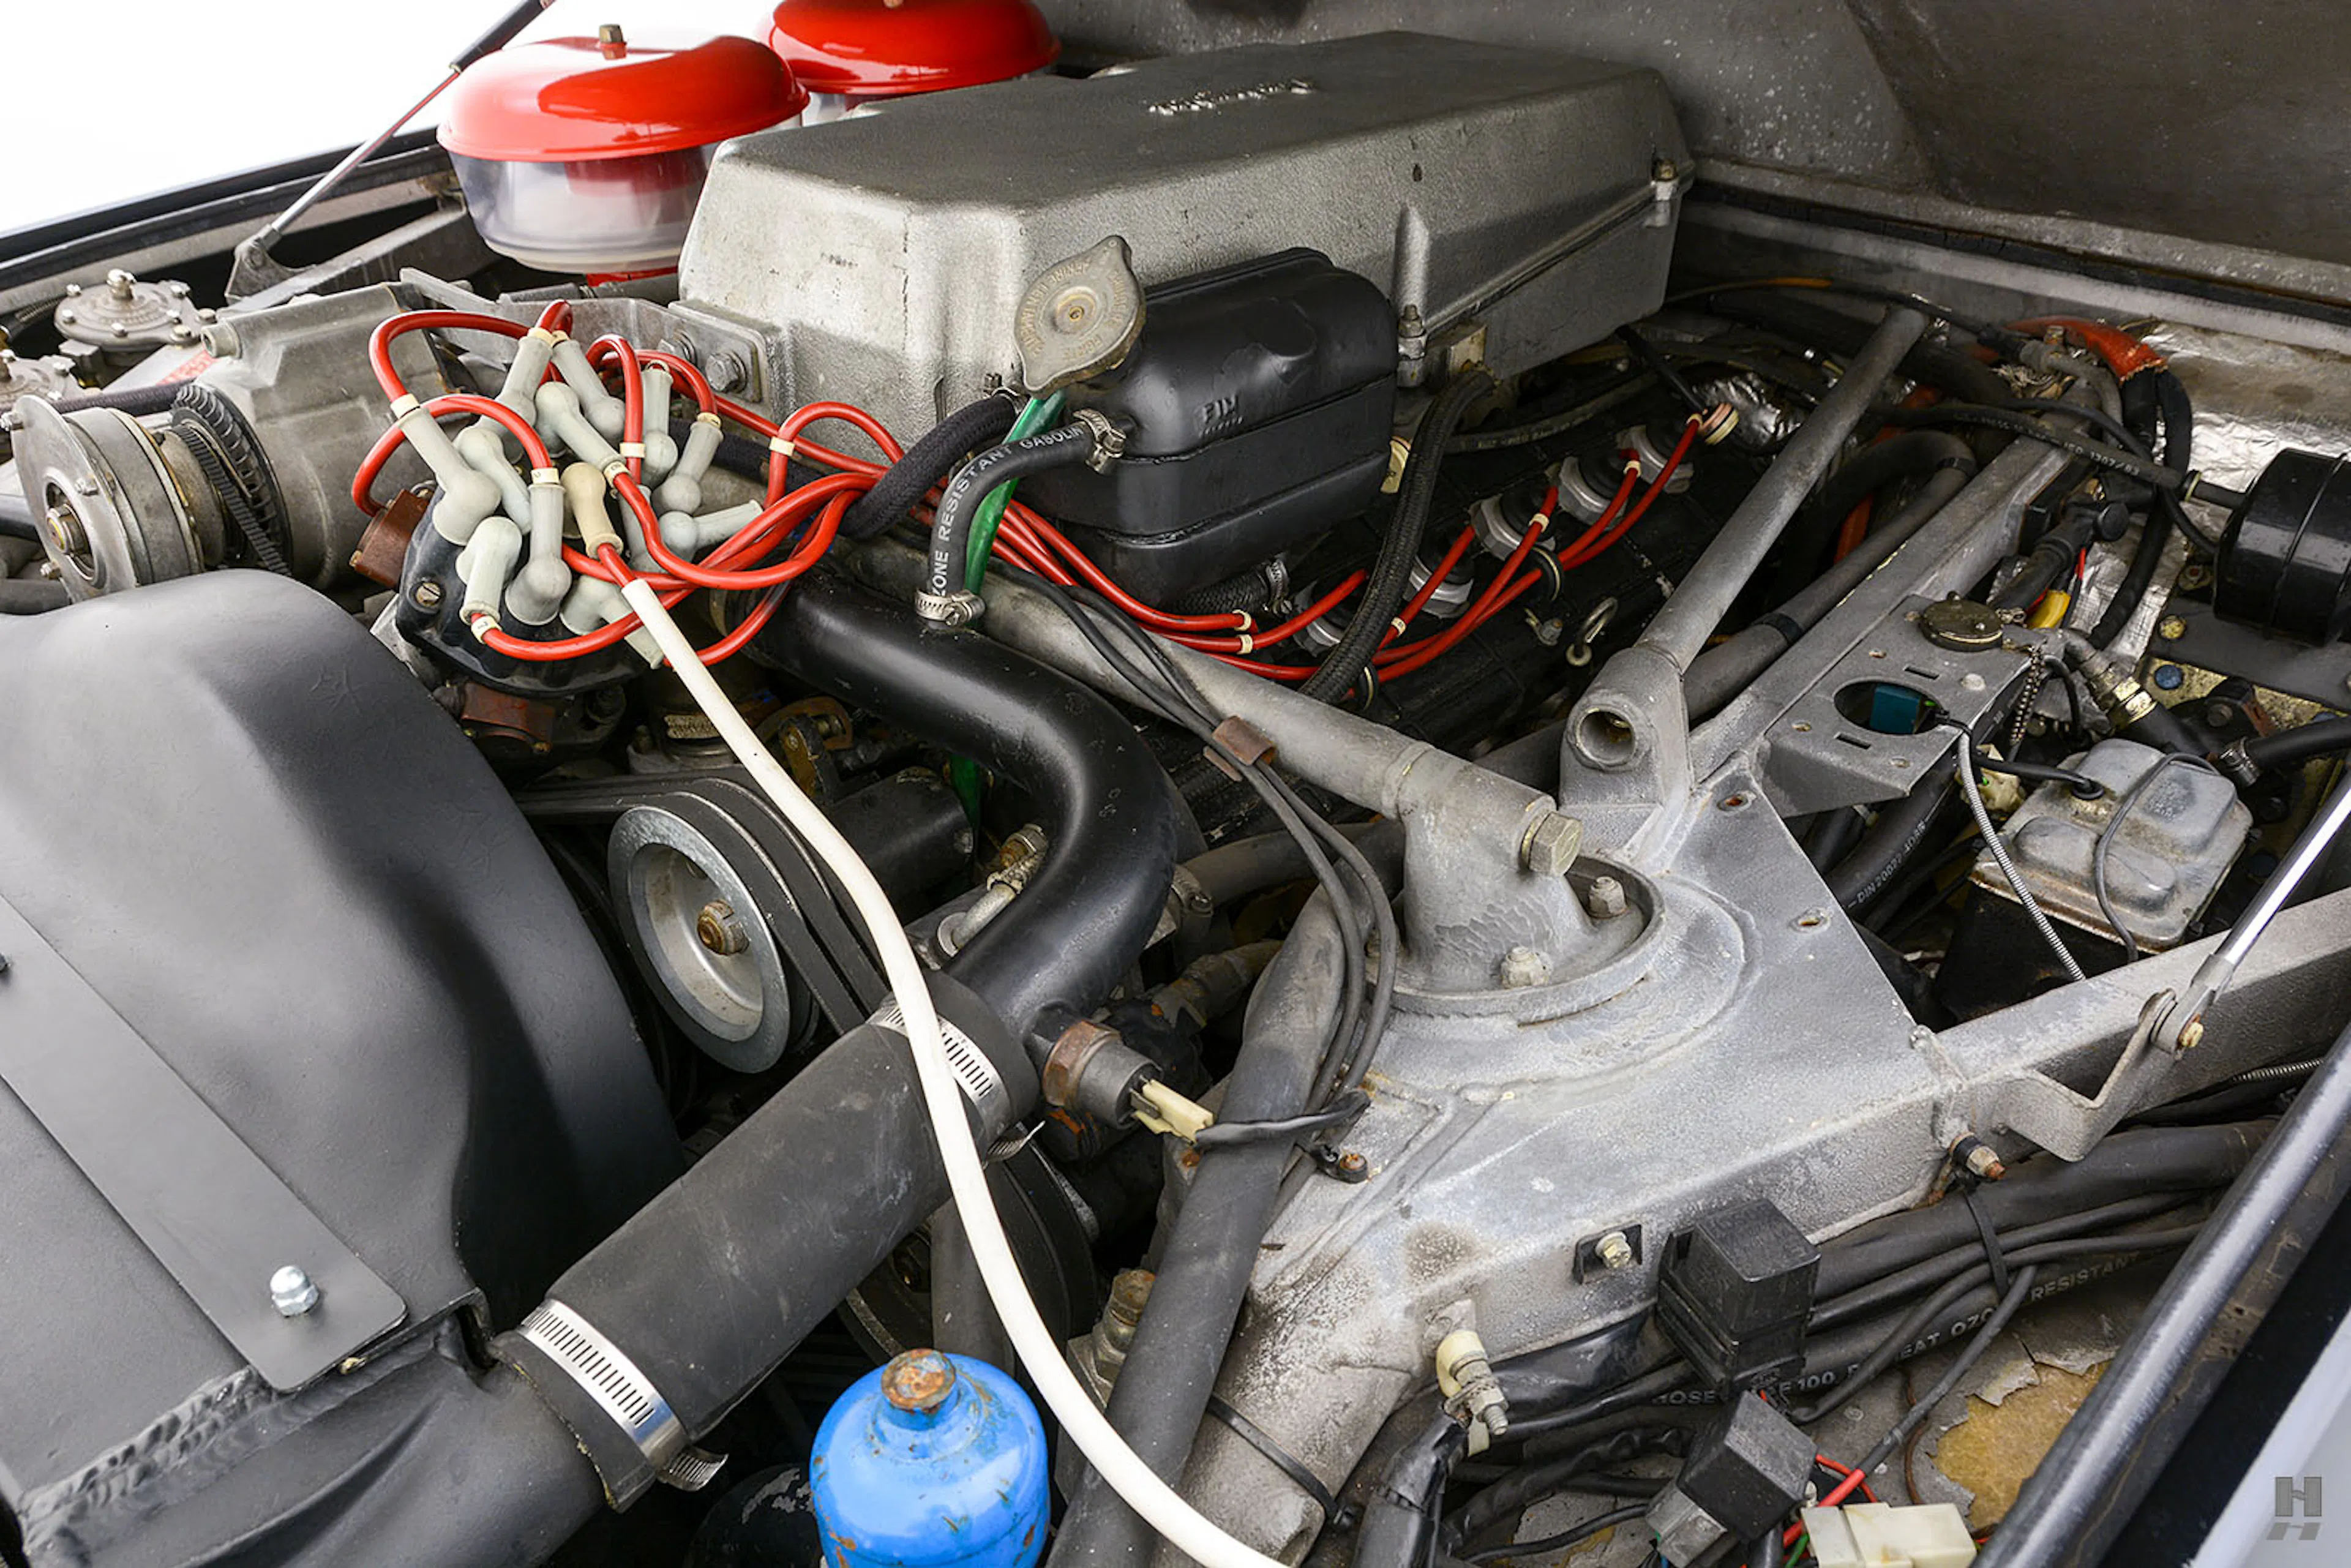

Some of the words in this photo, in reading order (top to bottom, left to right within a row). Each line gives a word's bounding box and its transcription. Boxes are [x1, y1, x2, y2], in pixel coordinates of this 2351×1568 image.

[1019, 426, 1084, 449] GASOLIN
[938, 445, 1013, 542] RESISTANT
[932, 550, 949, 597] ZONE
[1900, 1332, 1941, 1359] EAT
[2031, 1251, 2140, 1302] RESISTANT
